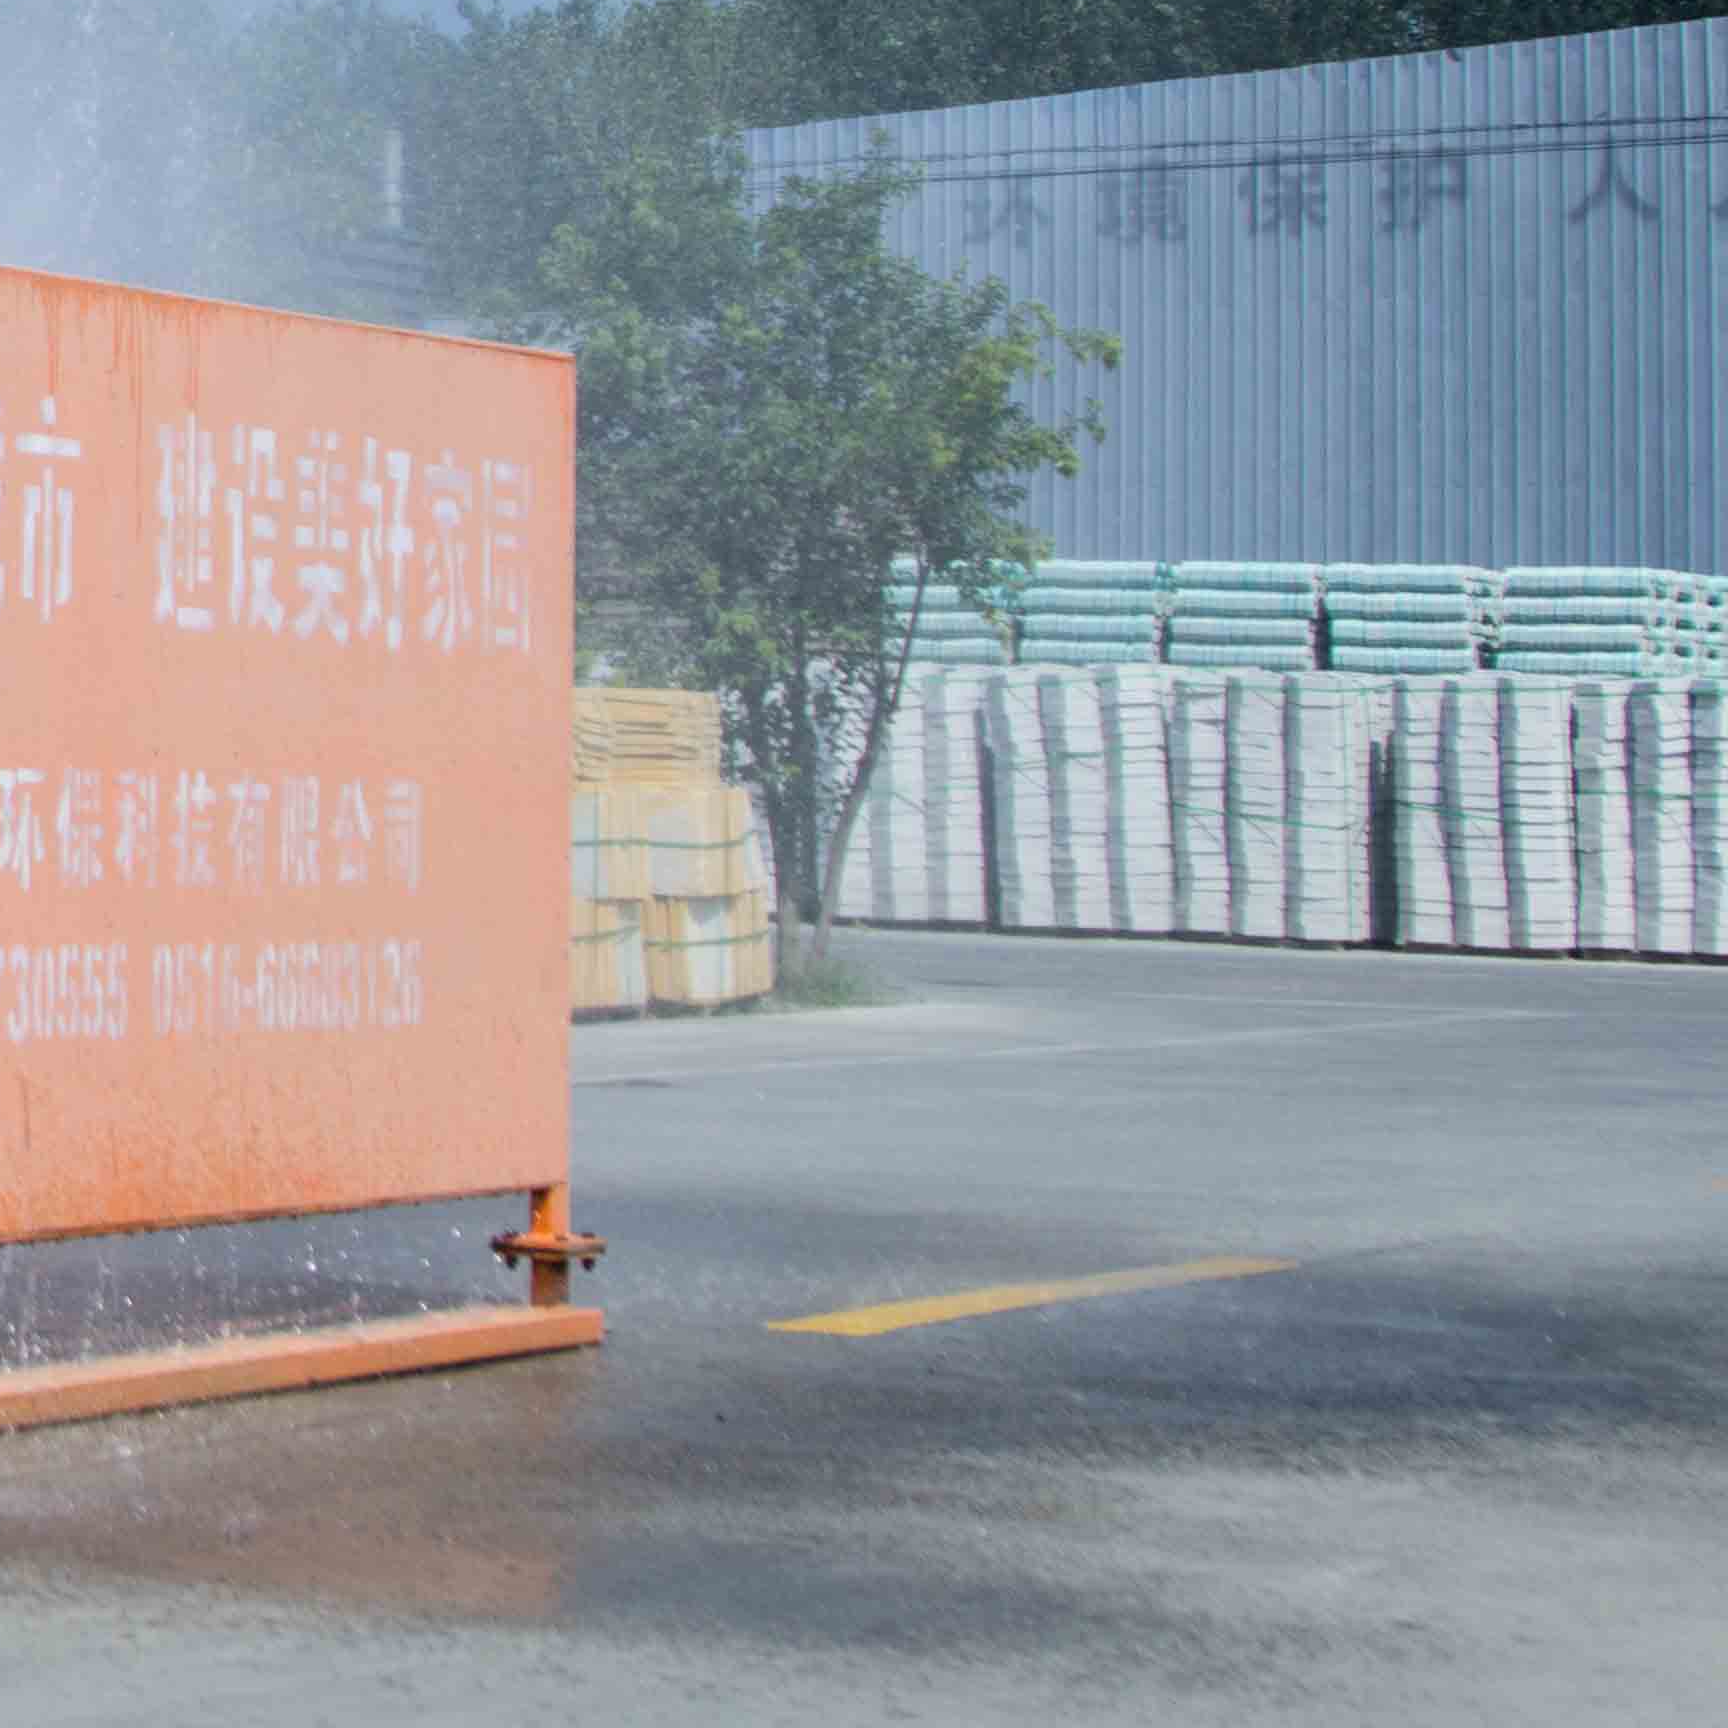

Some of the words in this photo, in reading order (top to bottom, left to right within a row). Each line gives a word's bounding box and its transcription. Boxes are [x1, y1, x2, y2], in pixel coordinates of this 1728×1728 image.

[962, 139, 1467, 248] 环境保护
[152, 410, 534, 653] 建设美好家园
